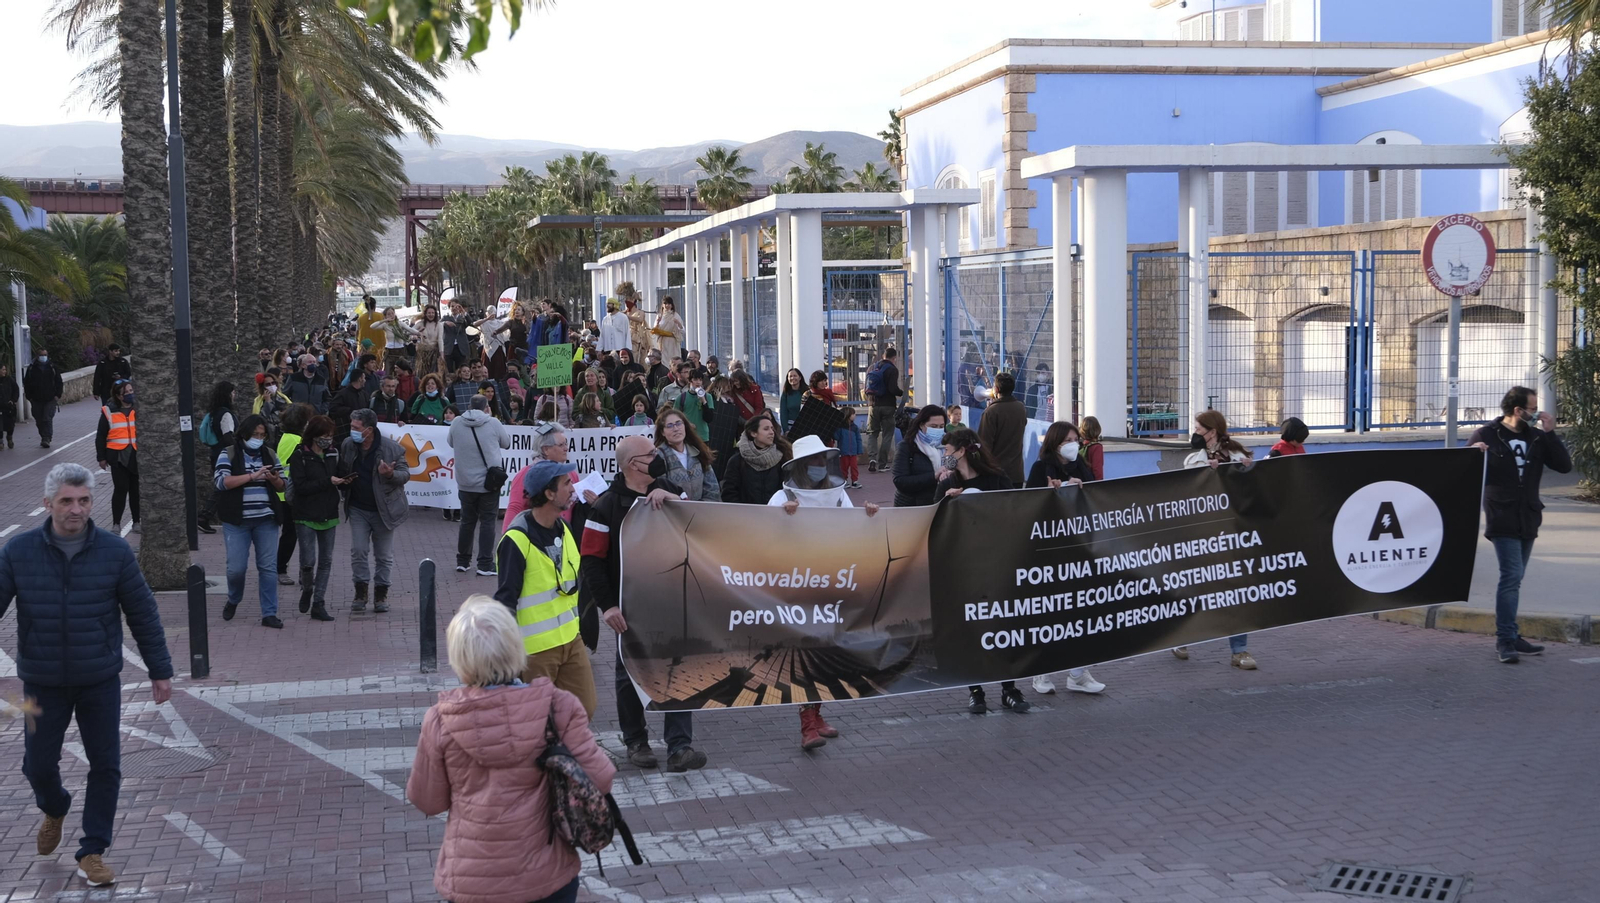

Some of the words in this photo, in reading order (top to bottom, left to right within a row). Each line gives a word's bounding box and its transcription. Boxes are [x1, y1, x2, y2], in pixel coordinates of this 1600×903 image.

[1436, 215, 1484, 232] EXCEPTO
[545, 361, 564, 370] VALLE
[581, 436, 596, 451] LA
[576, 454, 596, 474] VÍA
[431, 489, 452, 497] TORRES
[1030, 516, 1091, 540] ALIANZA
[1092, 503, 1145, 532] ENERGÍA
[1146, 505, 1155, 521] Y
[1156, 493, 1230, 520] TERRITORIO
[1016, 565, 1054, 586] POR
[1058, 560, 1092, 581] UNA
[1094, 543, 1172, 575] TRANSICIÓN
[1174, 530, 1262, 560] ENERGÉTICA
[1347, 547, 1428, 565] ALIENTE
[720, 565, 830, 589] Renovables
[835, 564, 858, 591] SÍ,
[964, 592, 1073, 621] REALMENTE
[1076, 578, 1161, 608] ECOLÓGICA,
[1162, 561, 1242, 591] SOSTENIBLE
[1243, 558, 1254, 575] Y
[1258, 551, 1308, 573] JUSTA
[729, 608, 774, 631] pero
[776, 605, 807, 625] NO
[812, 601, 844, 625] ASÍ.
[981, 629, 1025, 650] CON
[1029, 620, 1084, 645] TODAS
[1087, 614, 1114, 635] LAS
[1116, 603, 1187, 630] PERSONAS
[1189, 596, 1199, 614] Y
[1199, 579, 1297, 611] TERRITORIOS
